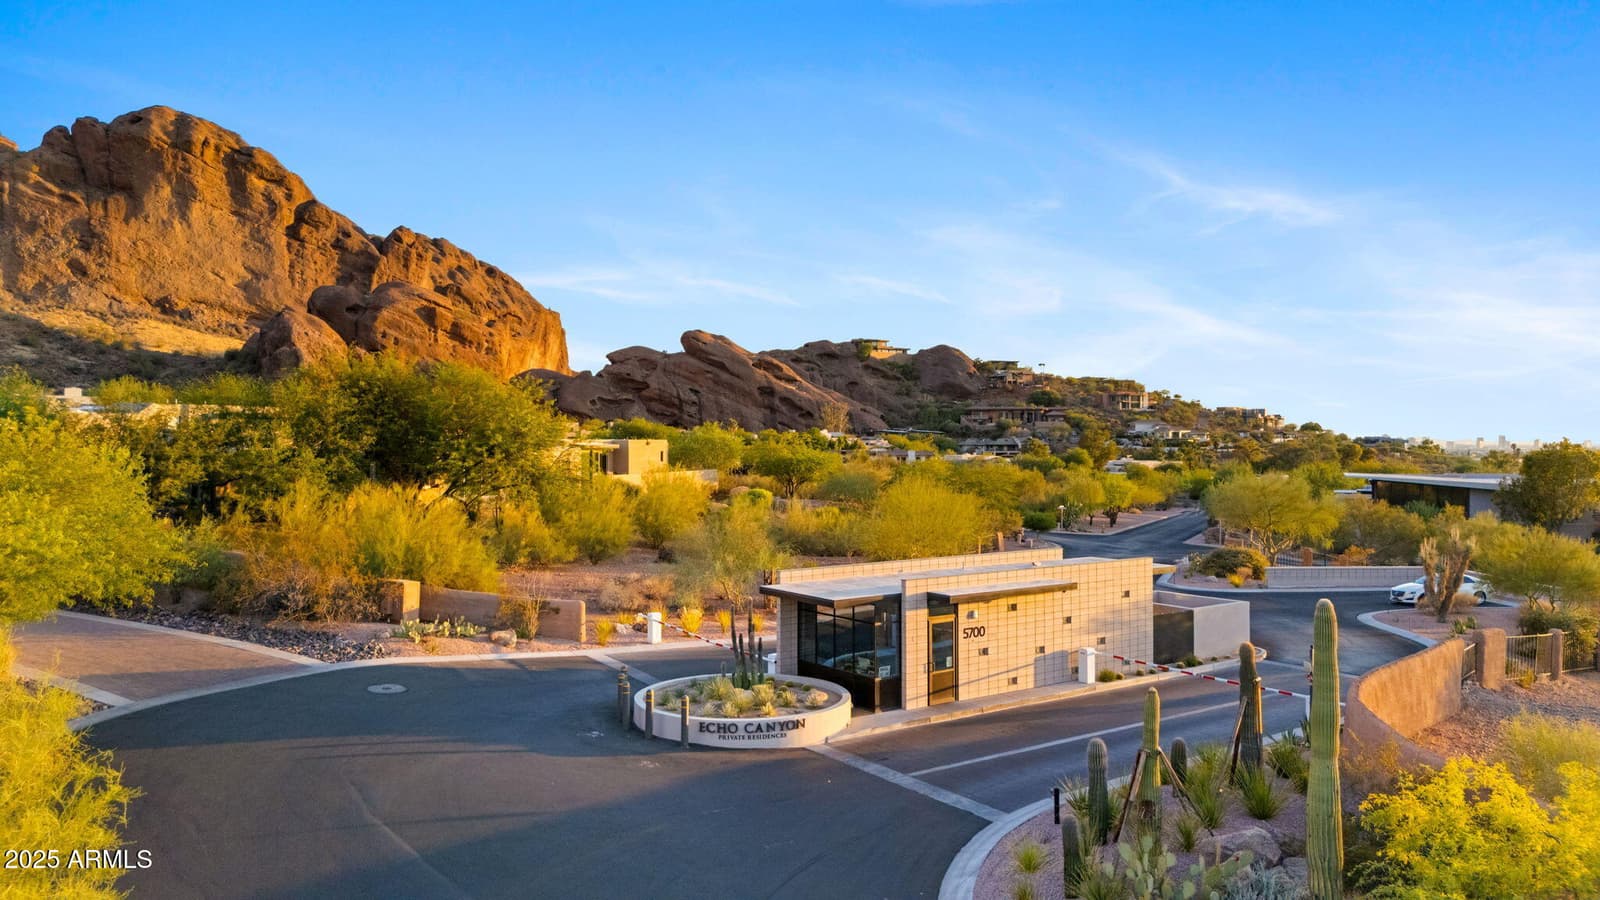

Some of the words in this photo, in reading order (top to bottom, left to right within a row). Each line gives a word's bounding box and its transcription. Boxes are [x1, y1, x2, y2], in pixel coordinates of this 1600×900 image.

[963, 626, 985, 639] 5700
[699, 722, 738, 734] ECHO
[744, 718, 806, 734] CANYON
